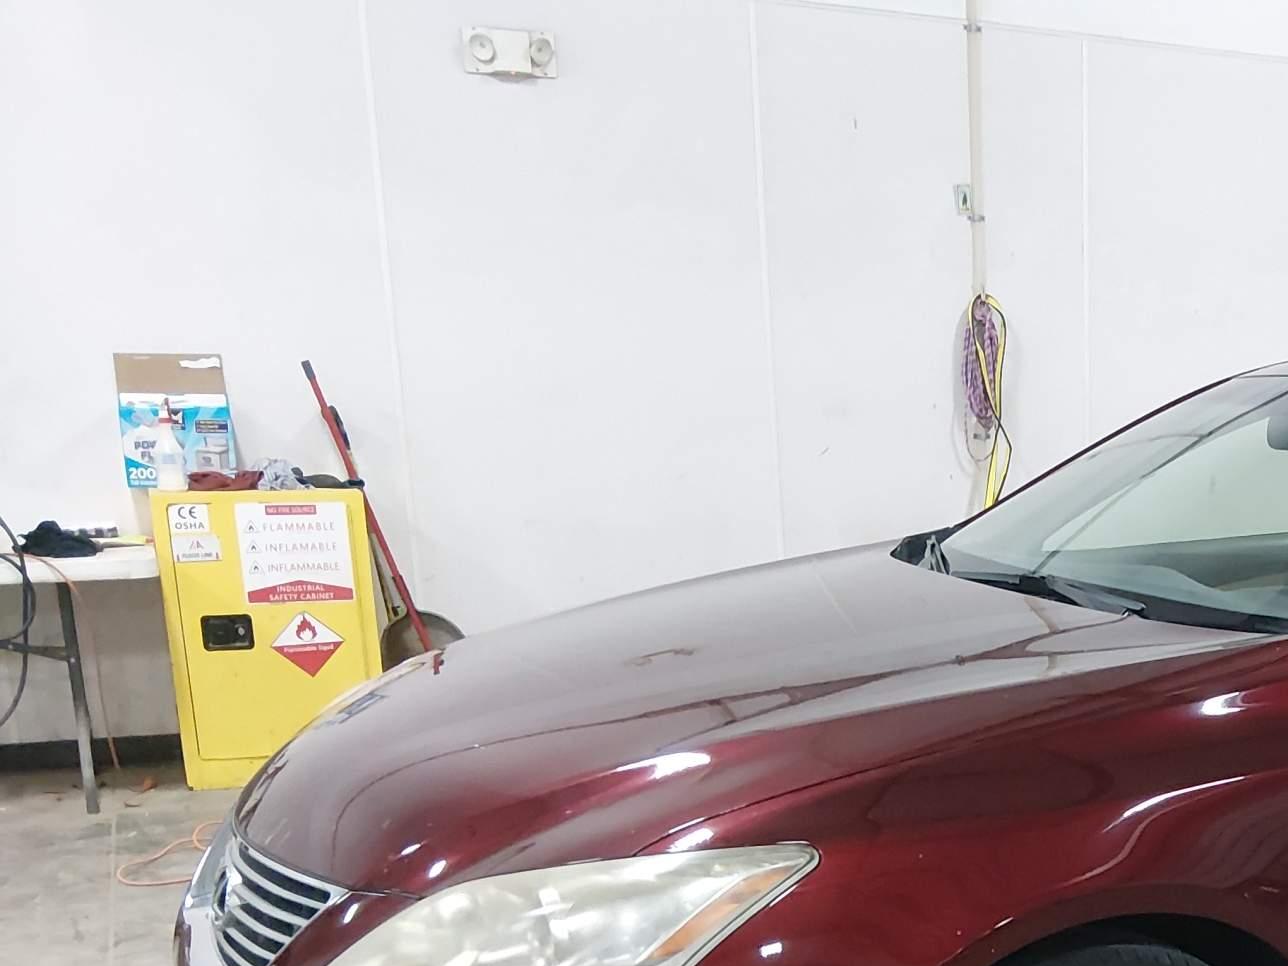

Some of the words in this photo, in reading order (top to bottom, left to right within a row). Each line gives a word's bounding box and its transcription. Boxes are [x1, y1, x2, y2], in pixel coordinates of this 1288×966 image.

[128, 467, 156, 480] 200
[174, 521, 206, 530] OSHA
[262, 521, 336, 532] FLAMMABLE
[264, 542, 337, 552] INFLAMABLE
[267, 562, 341, 573] INFLAMMABLE
[276, 584, 325, 593] INDUSTRIAL
[268, 593, 298, 601] SAFETY
[299, 592, 335, 600] CABINET
